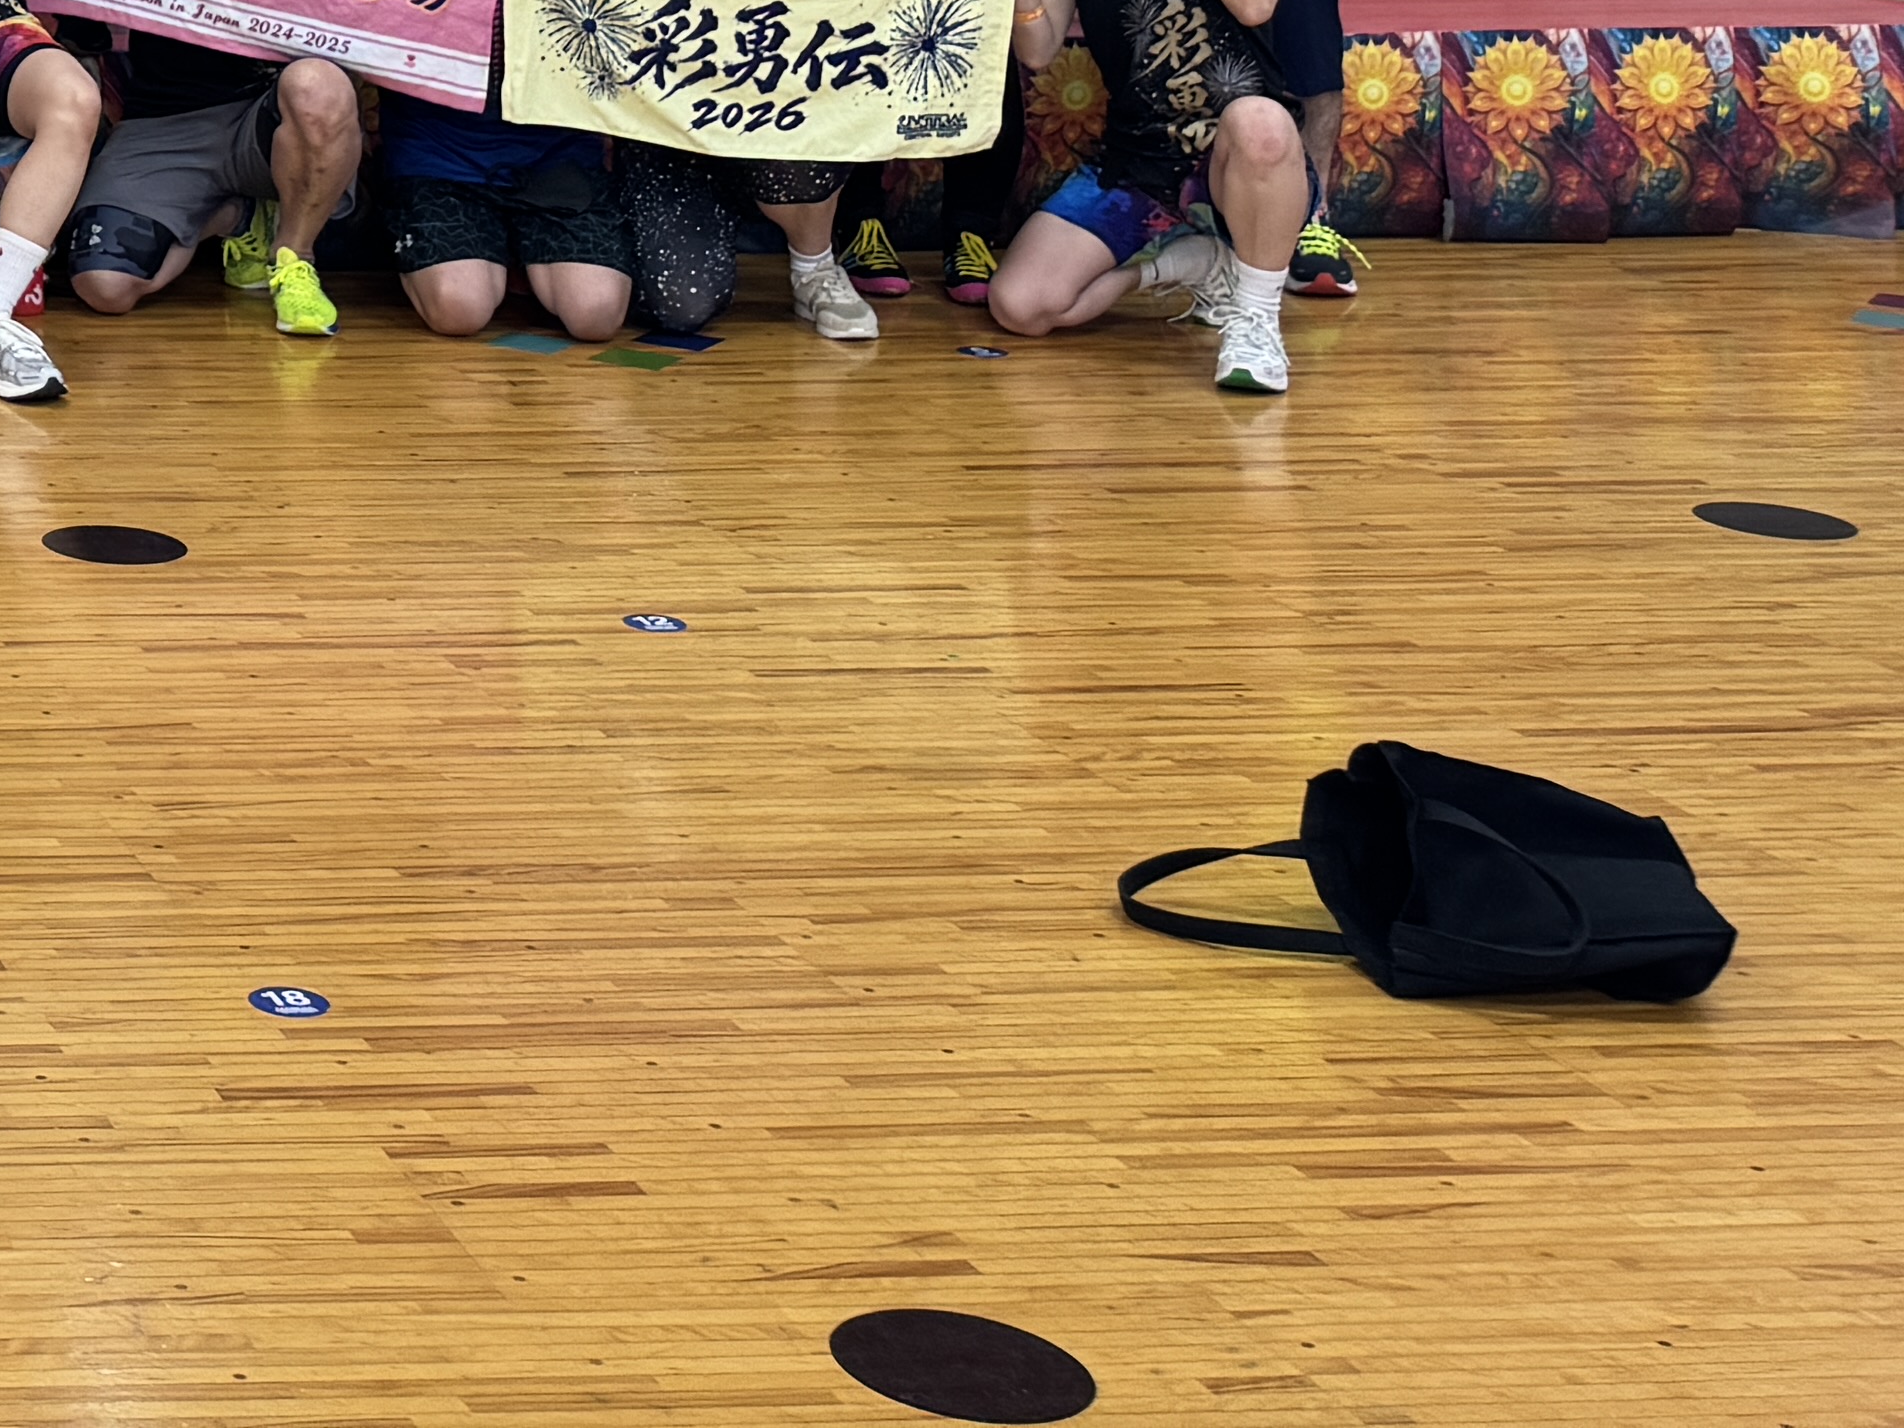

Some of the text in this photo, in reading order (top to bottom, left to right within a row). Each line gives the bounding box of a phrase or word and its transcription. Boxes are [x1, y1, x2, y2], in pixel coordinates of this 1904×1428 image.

[192, 3, 241, 28] Japan
[248, 17, 353, 55] 2024-2025
[690, 95, 807, 132] 2026
[632, 615, 674, 627] 12
[260, 988, 312, 1007] 18
